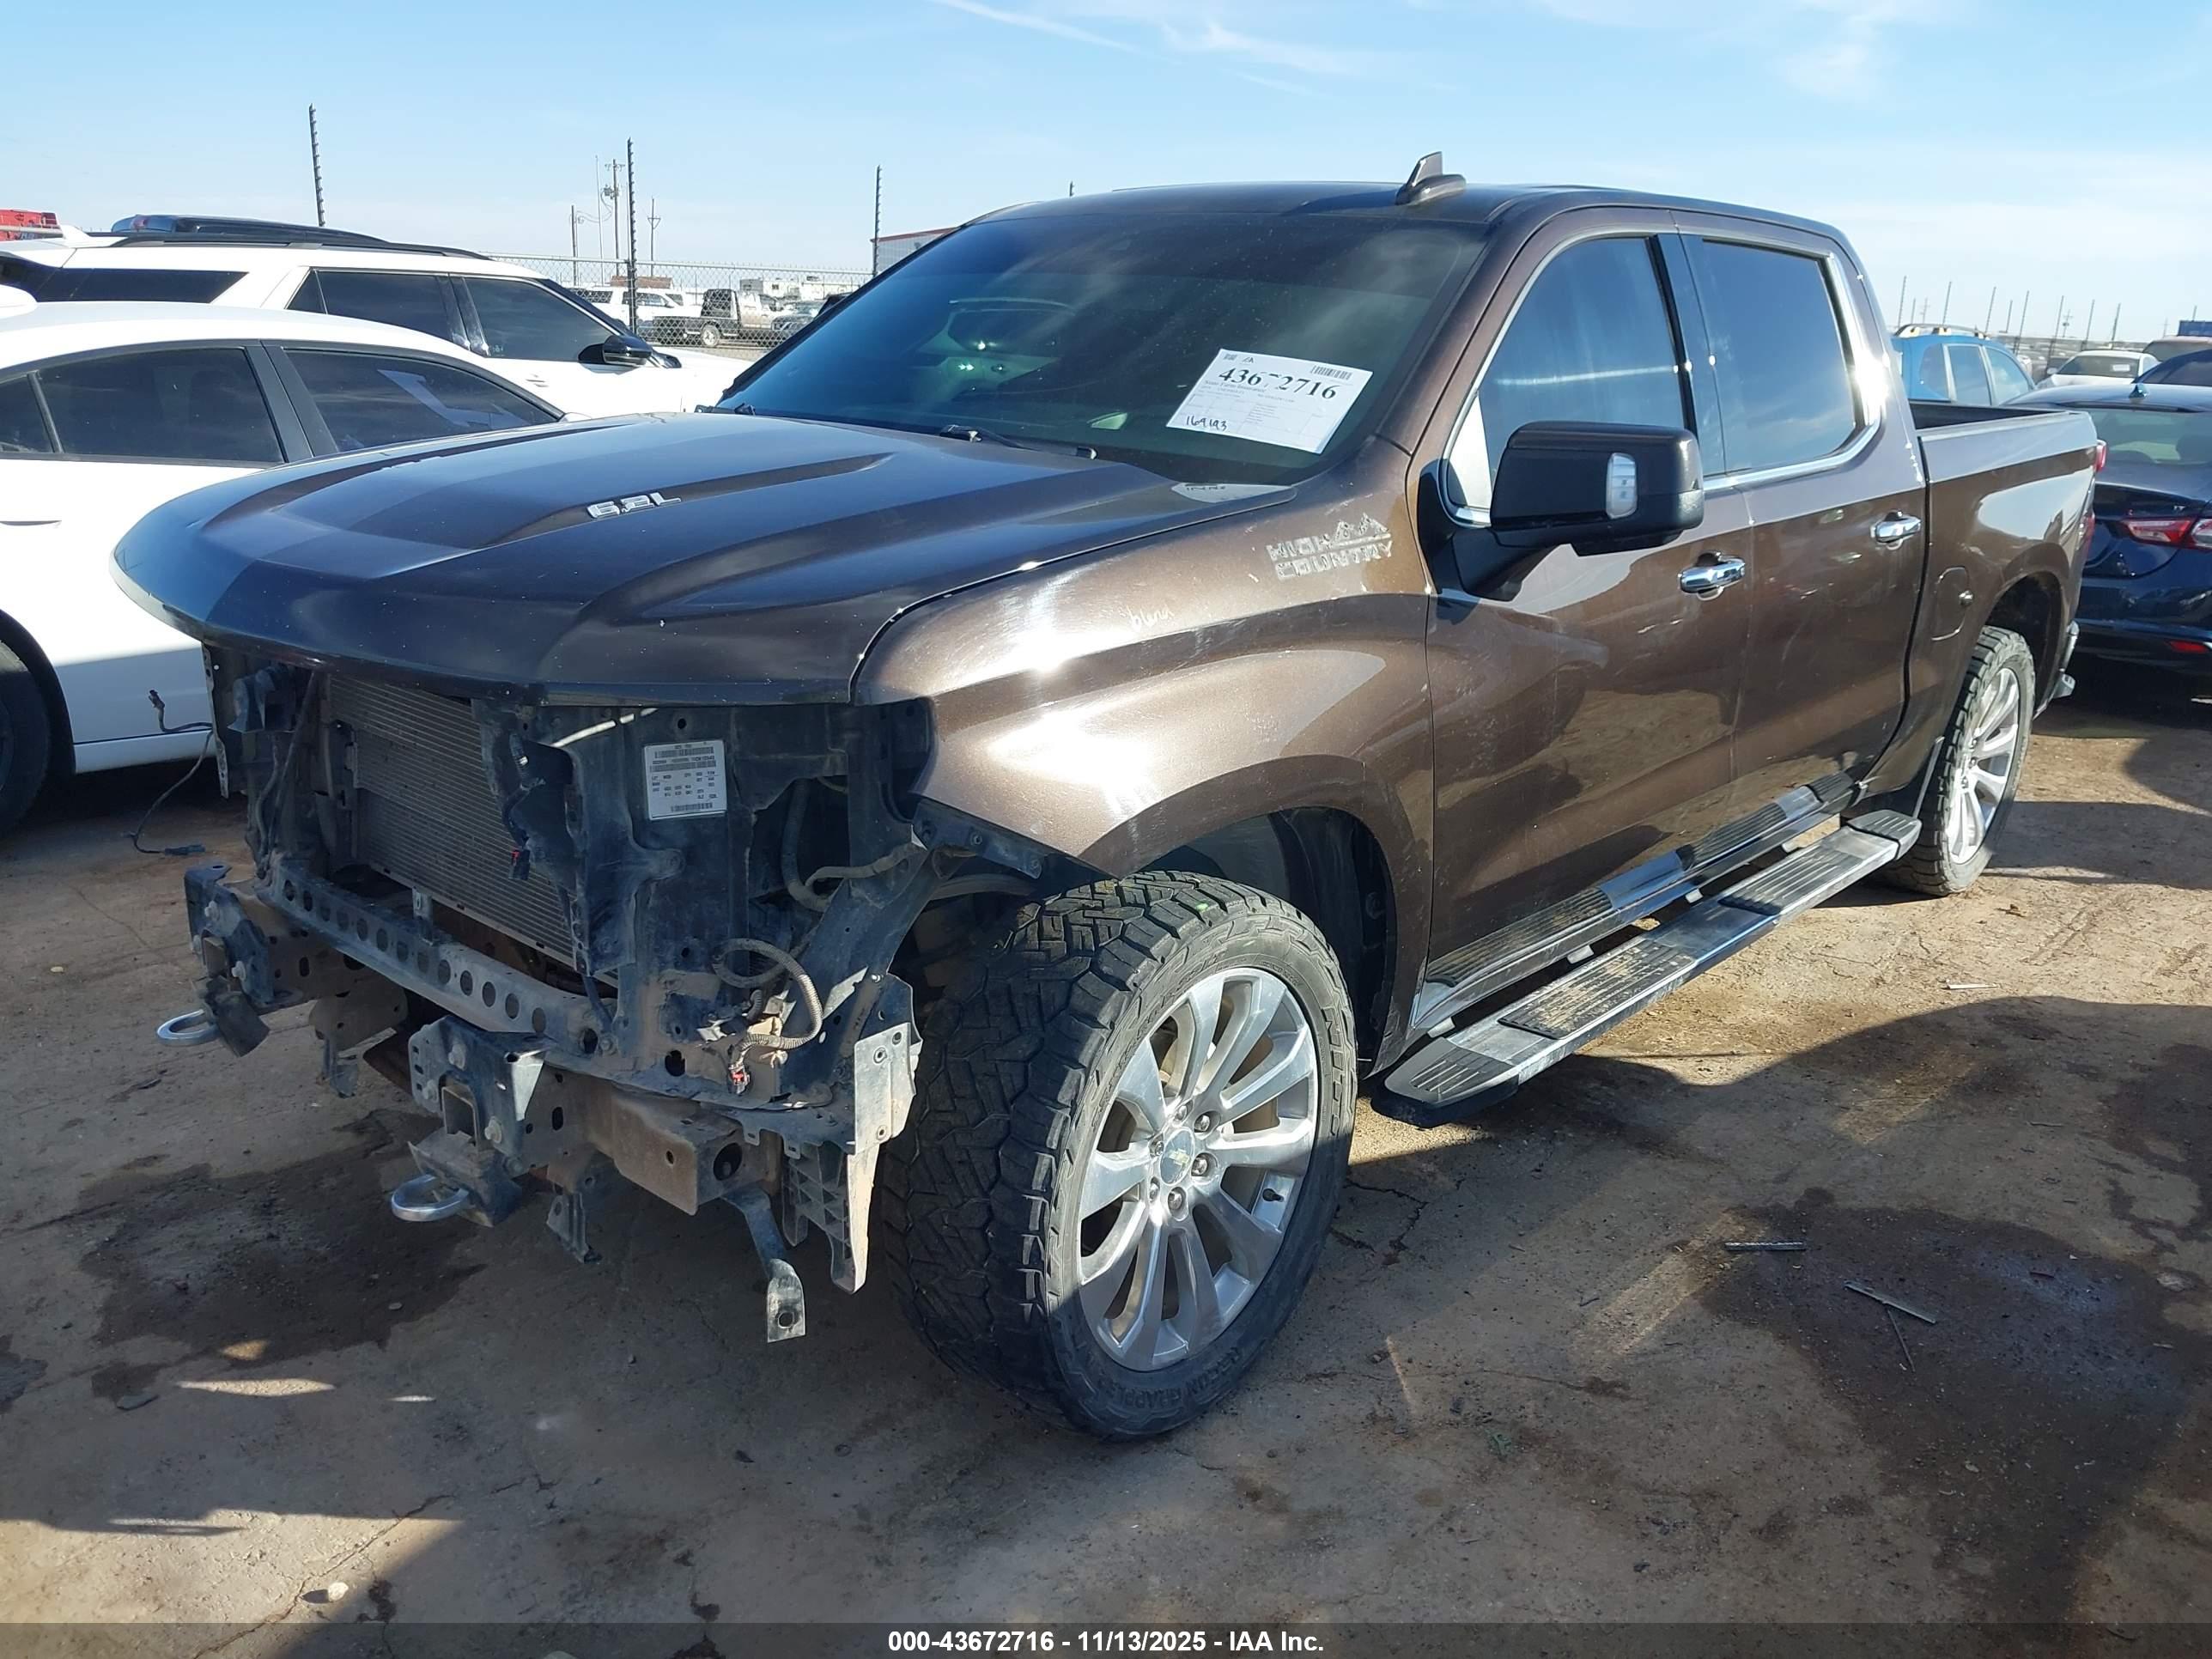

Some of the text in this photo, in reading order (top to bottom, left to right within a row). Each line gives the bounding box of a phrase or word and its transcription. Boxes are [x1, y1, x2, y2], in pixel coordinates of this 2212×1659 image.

[586, 492, 682, 519] 6.2L
[1266, 533, 1333, 562] HIGH
[1274, 541, 1393, 580] COUNTRY
[1321, 1007, 1345, 1144] NITT
